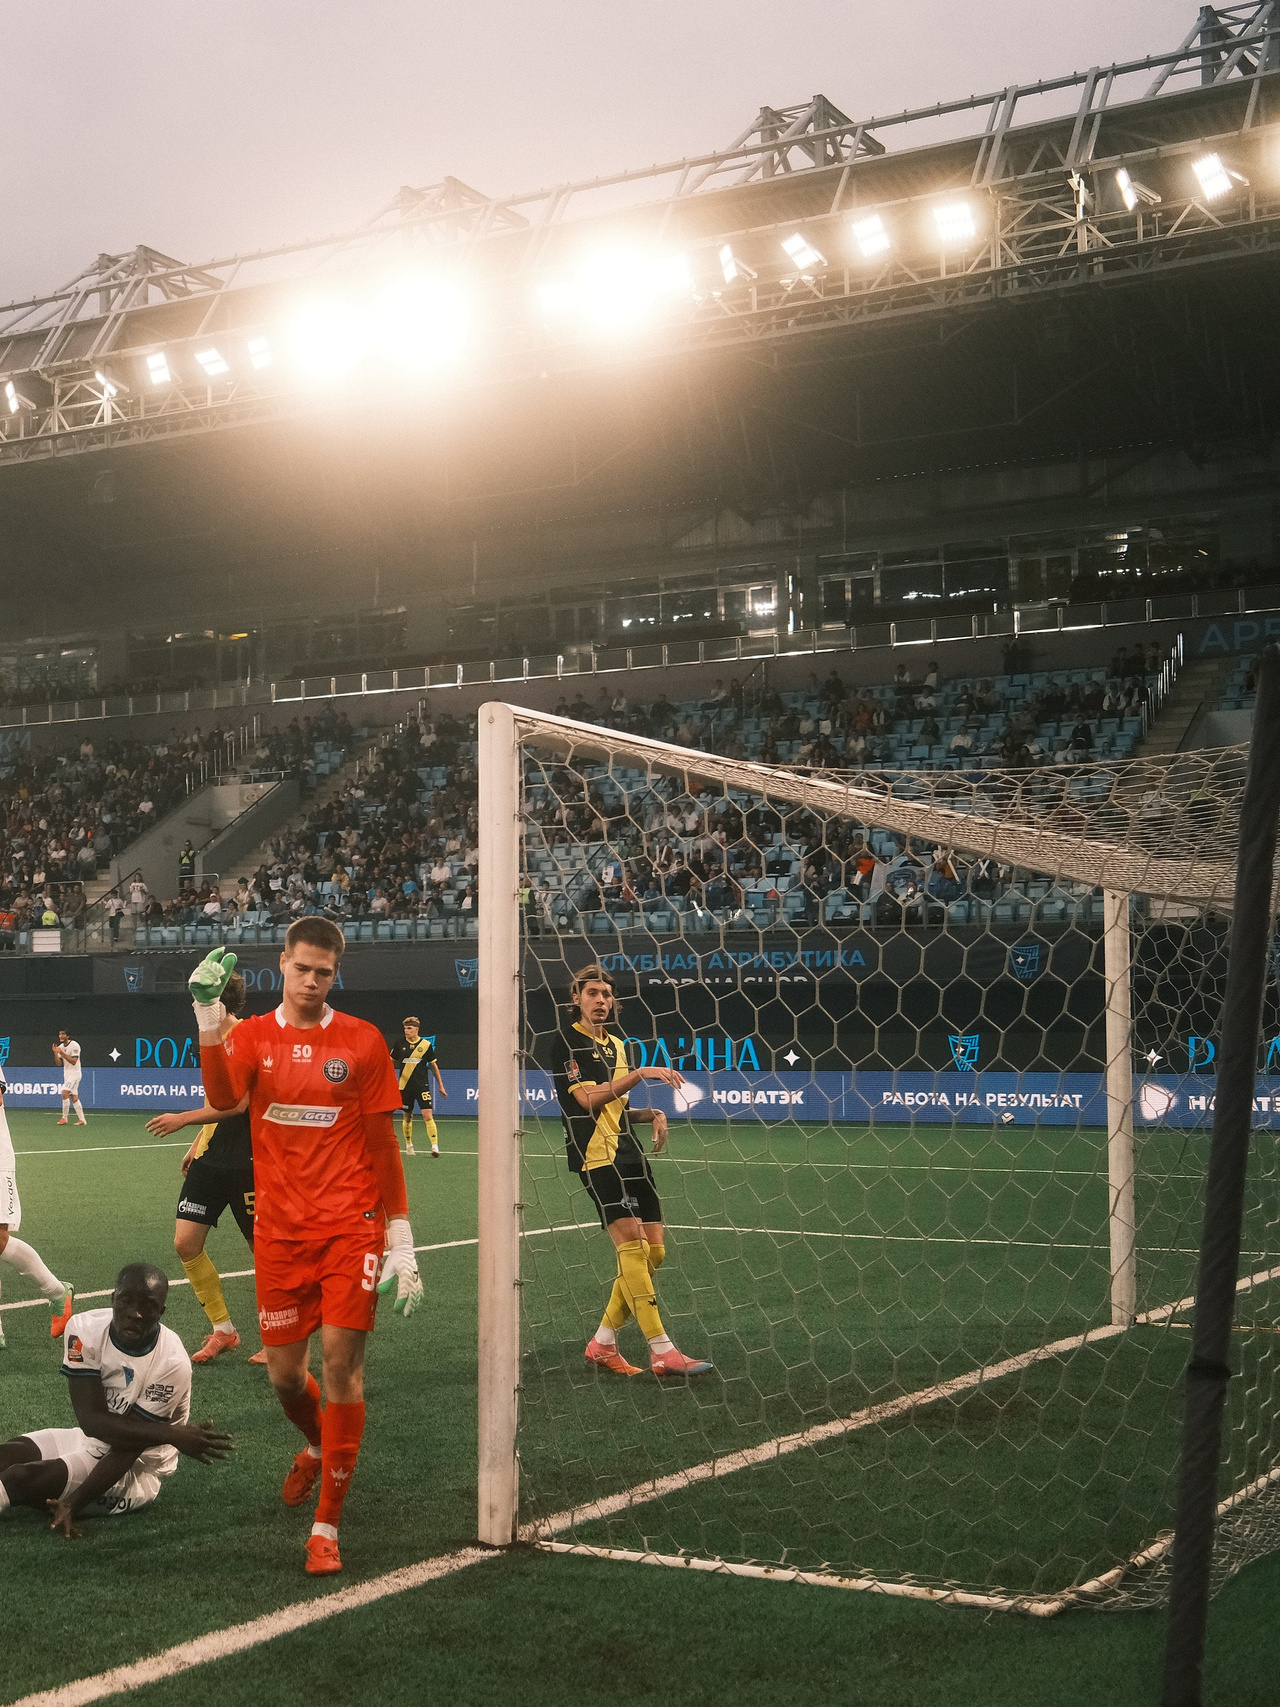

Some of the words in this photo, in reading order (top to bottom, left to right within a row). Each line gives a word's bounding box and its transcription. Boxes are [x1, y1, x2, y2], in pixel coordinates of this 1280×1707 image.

[708, 950, 866, 970] АТРИБУТИКА
[292, 1044, 313, 1058] 50
[120, 1085, 166, 1097] РАБОТА
[169, 1085, 187, 1097] НА
[421, 1091, 432, 1101] 65
[525, 1089, 547, 1101] НА
[712, 1090, 804, 1104] НОВАТЭК
[882, 1091, 941, 1106] РАБОТА
[955, 1092, 979, 1106] НА
[986, 1093, 1083, 1108] РЕЗУЛЬТАТ
[361, 1252, 383, 1291] 9
[267, 1306, 298, 1321] ГАЗПРОМ
